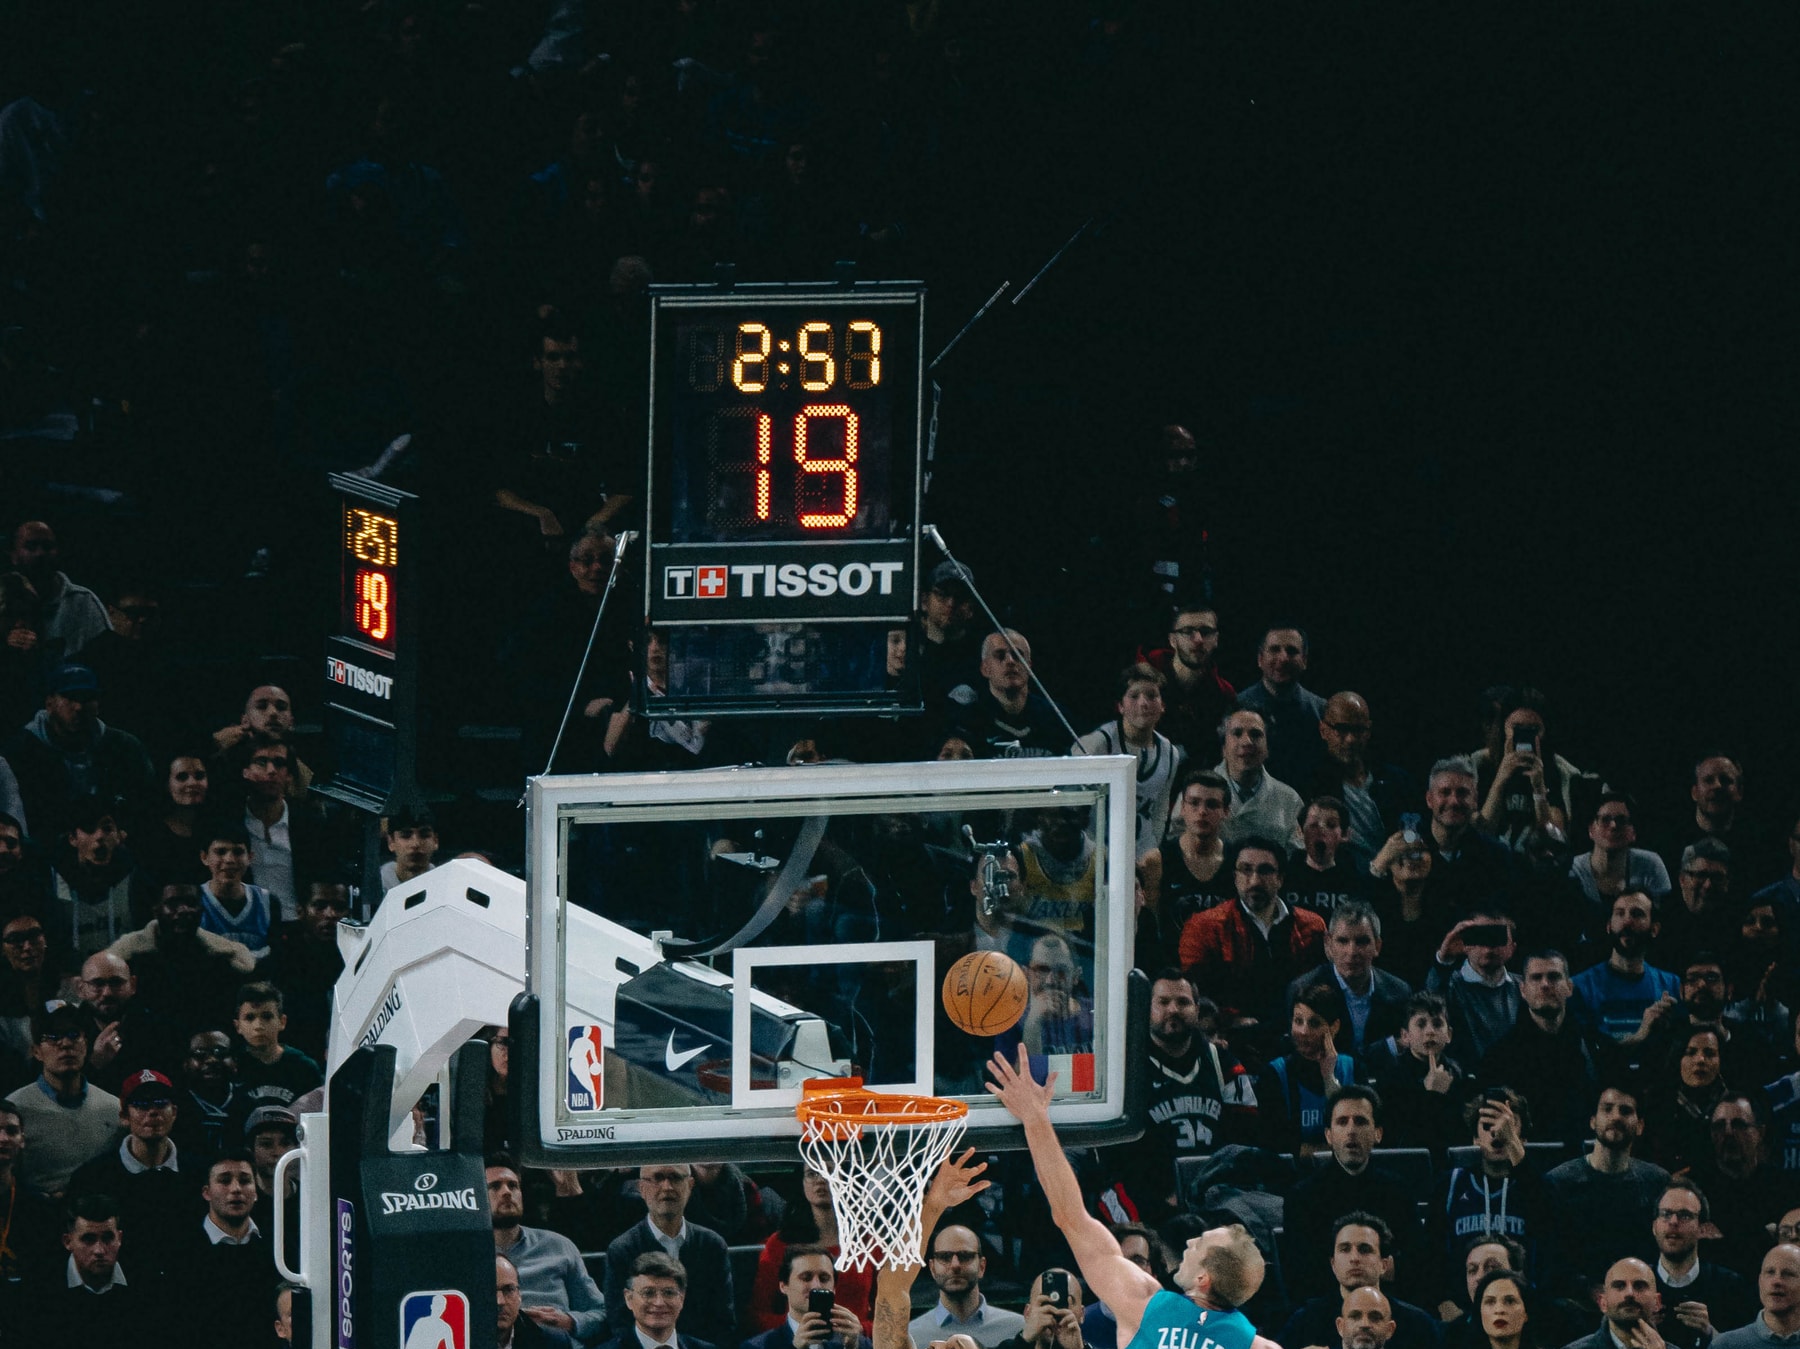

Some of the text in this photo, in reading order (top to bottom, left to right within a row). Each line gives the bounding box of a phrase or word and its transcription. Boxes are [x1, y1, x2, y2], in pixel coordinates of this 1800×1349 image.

[733, 322, 881, 391] 2:57
[756, 405, 858, 527] 19
[731, 562, 904, 597] TISSOT
[346, 663, 393, 699] TISSOT
[571, 1093, 589, 1107] NBA
[557, 1126, 616, 1142] SPALDING
[1171, 1118, 1213, 1148] 34
[381, 1188, 479, 1215] SPALDING
[342, 1211, 353, 1339] SPORTS
